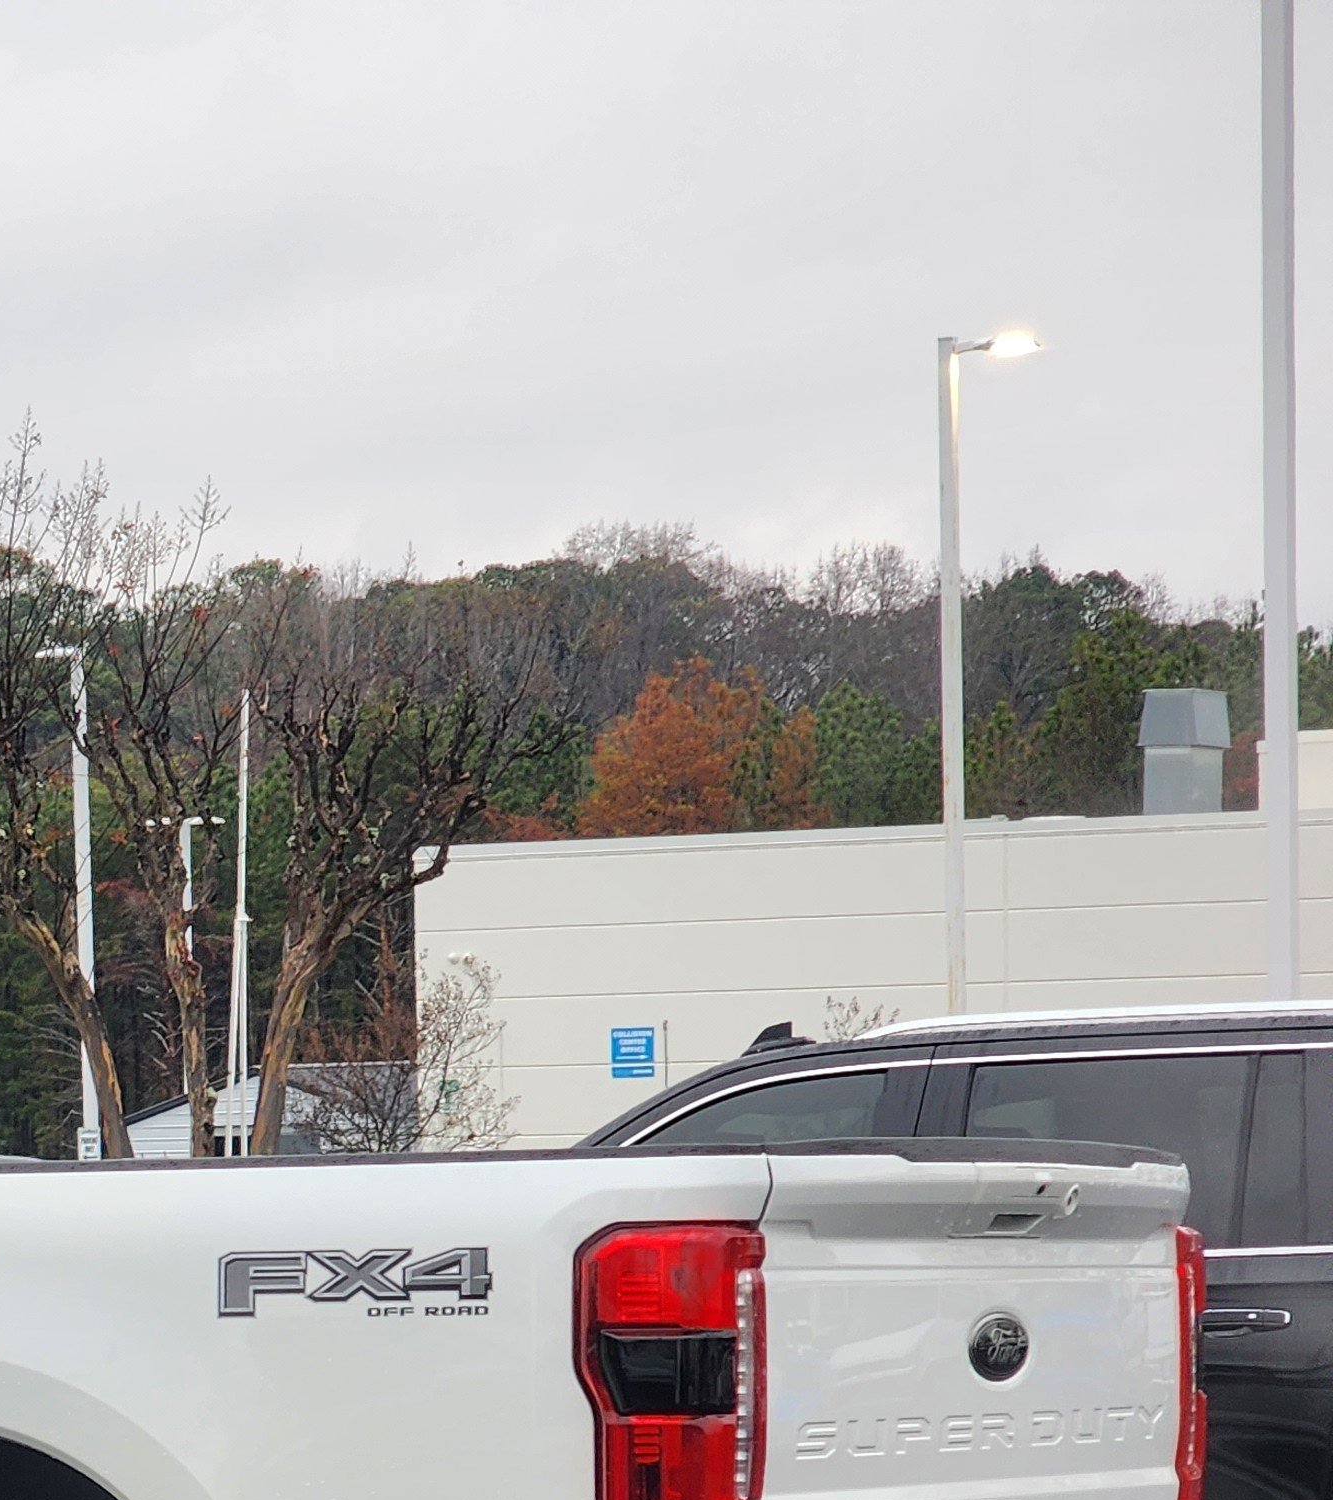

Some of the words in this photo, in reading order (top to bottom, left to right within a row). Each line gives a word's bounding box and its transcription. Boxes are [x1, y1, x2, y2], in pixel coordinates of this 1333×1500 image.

[217, 1247, 493, 1319] FX4
[367, 1306, 415, 1318] OFF
[425, 1305, 489, 1317] ROAD
[795, 1412, 1015, 1461] SUPER
[1031, 1404, 1165, 1447] DUTY
